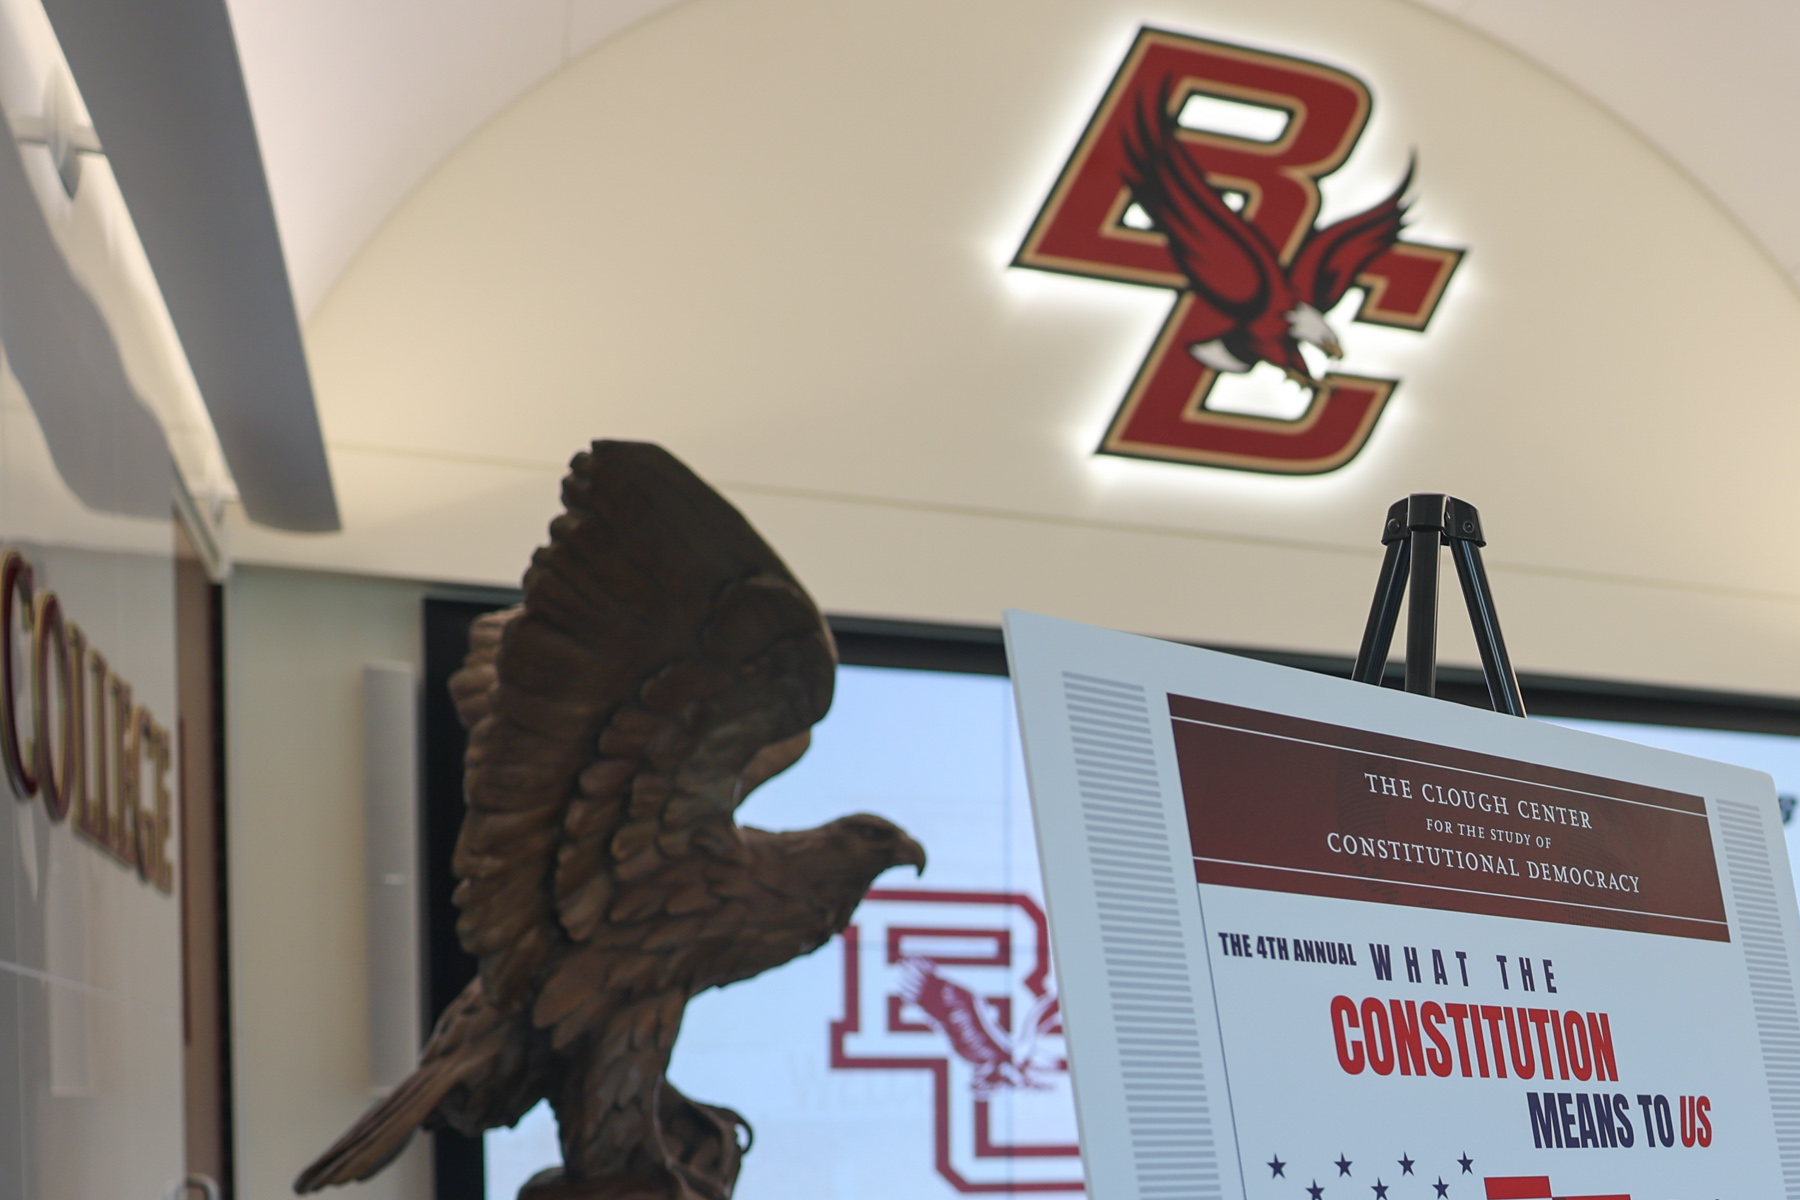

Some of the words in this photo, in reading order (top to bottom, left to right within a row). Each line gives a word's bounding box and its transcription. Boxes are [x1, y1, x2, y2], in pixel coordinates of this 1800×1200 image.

[0, 550, 173, 897] COLLEGE
[1364, 773, 1412, 799] THE
[1421, 783, 1509, 815] CLOUGH
[1517, 800, 1592, 829] CENTER
[1426, 818, 1453, 834] FOR
[1457, 823, 1485, 839] THE
[1490, 828, 1531, 846] STUDY
[1535, 836, 1551, 849] OF
[1327, 832, 1519, 876] CONSTITUTIONAL
[1526, 860, 1640, 893] DEMOCRACY
[1219, 932, 1253, 958] THE
[1256, 936, 1289, 960] 4TH
[1293, 938, 1357, 966] ANNUAL
[1369, 943, 1471, 987] WHAT
[1496, 955, 1558, 994] THE
[1330, 994, 1619, 1082] CONSTITUTION
[1527, 1092, 1635, 1149] MEANS
[1637, 1094, 1675, 1148] TO
[1680, 1095, 1713, 1148] US
